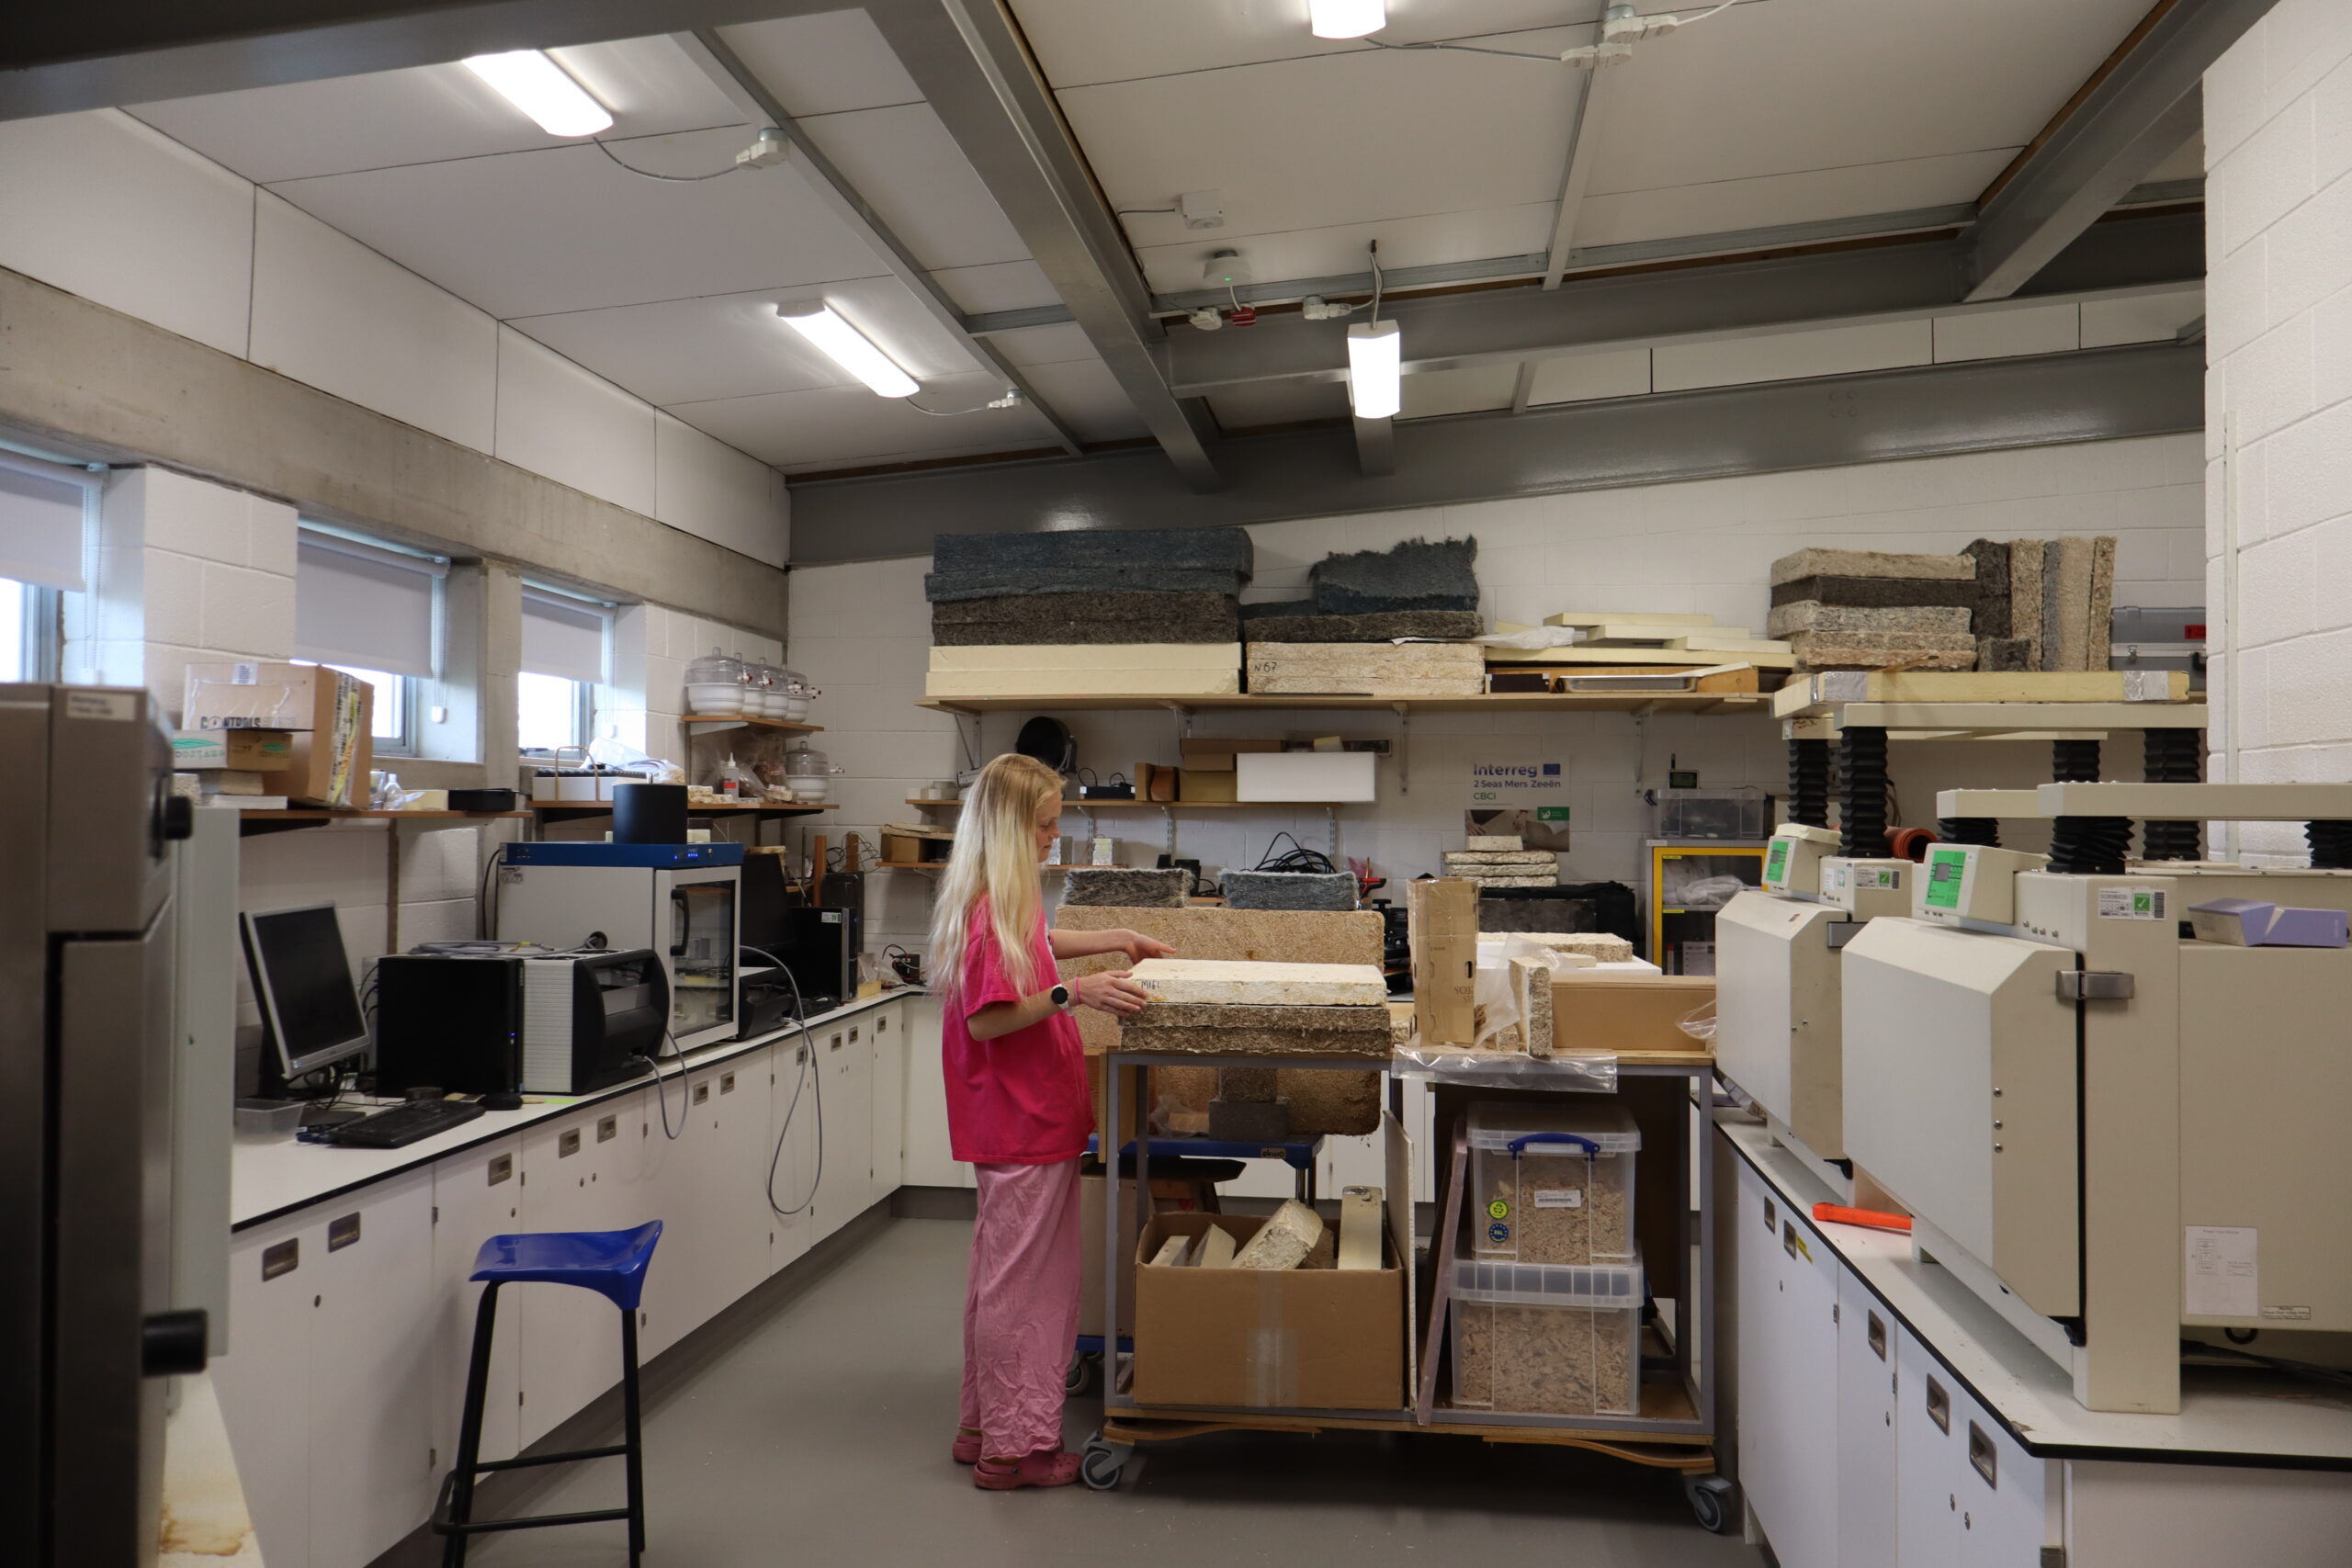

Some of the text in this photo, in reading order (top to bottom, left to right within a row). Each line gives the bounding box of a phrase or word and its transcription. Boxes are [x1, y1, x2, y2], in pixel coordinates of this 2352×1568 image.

[1473, 763, 1538, 778] Interreg
[1474, 780, 1479, 788] 2
[1481, 780, 1503, 788] Seas
[1505, 780, 1528, 788] Mers
[1473, 792, 1497, 801] CBCI
